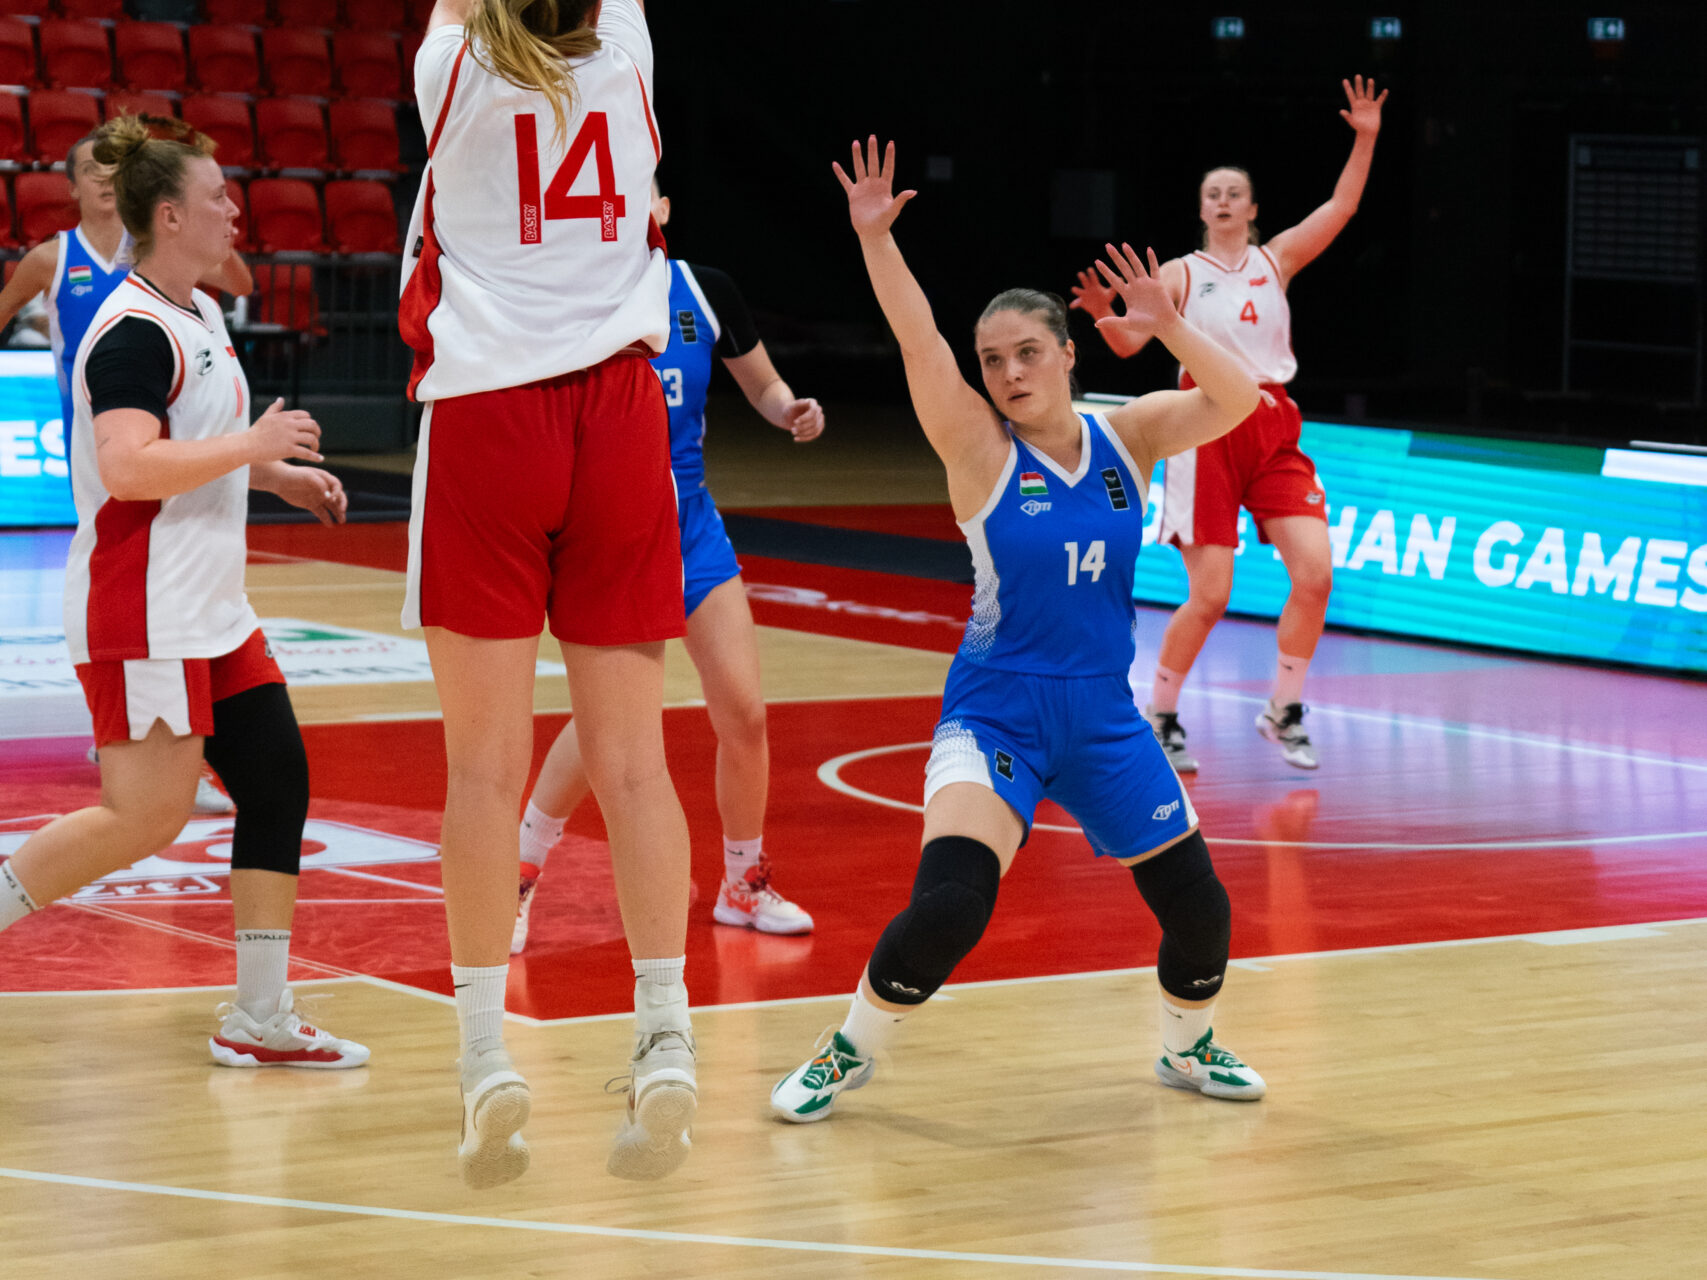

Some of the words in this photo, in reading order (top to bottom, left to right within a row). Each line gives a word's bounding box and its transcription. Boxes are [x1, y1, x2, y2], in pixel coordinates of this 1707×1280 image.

[514, 111, 626, 245] 14
[1240, 300, 1258, 325] 4
[1064, 540, 1106, 586] 14
[1322, 505, 1457, 580] HAN
[1473, 520, 1707, 613] GAMES
